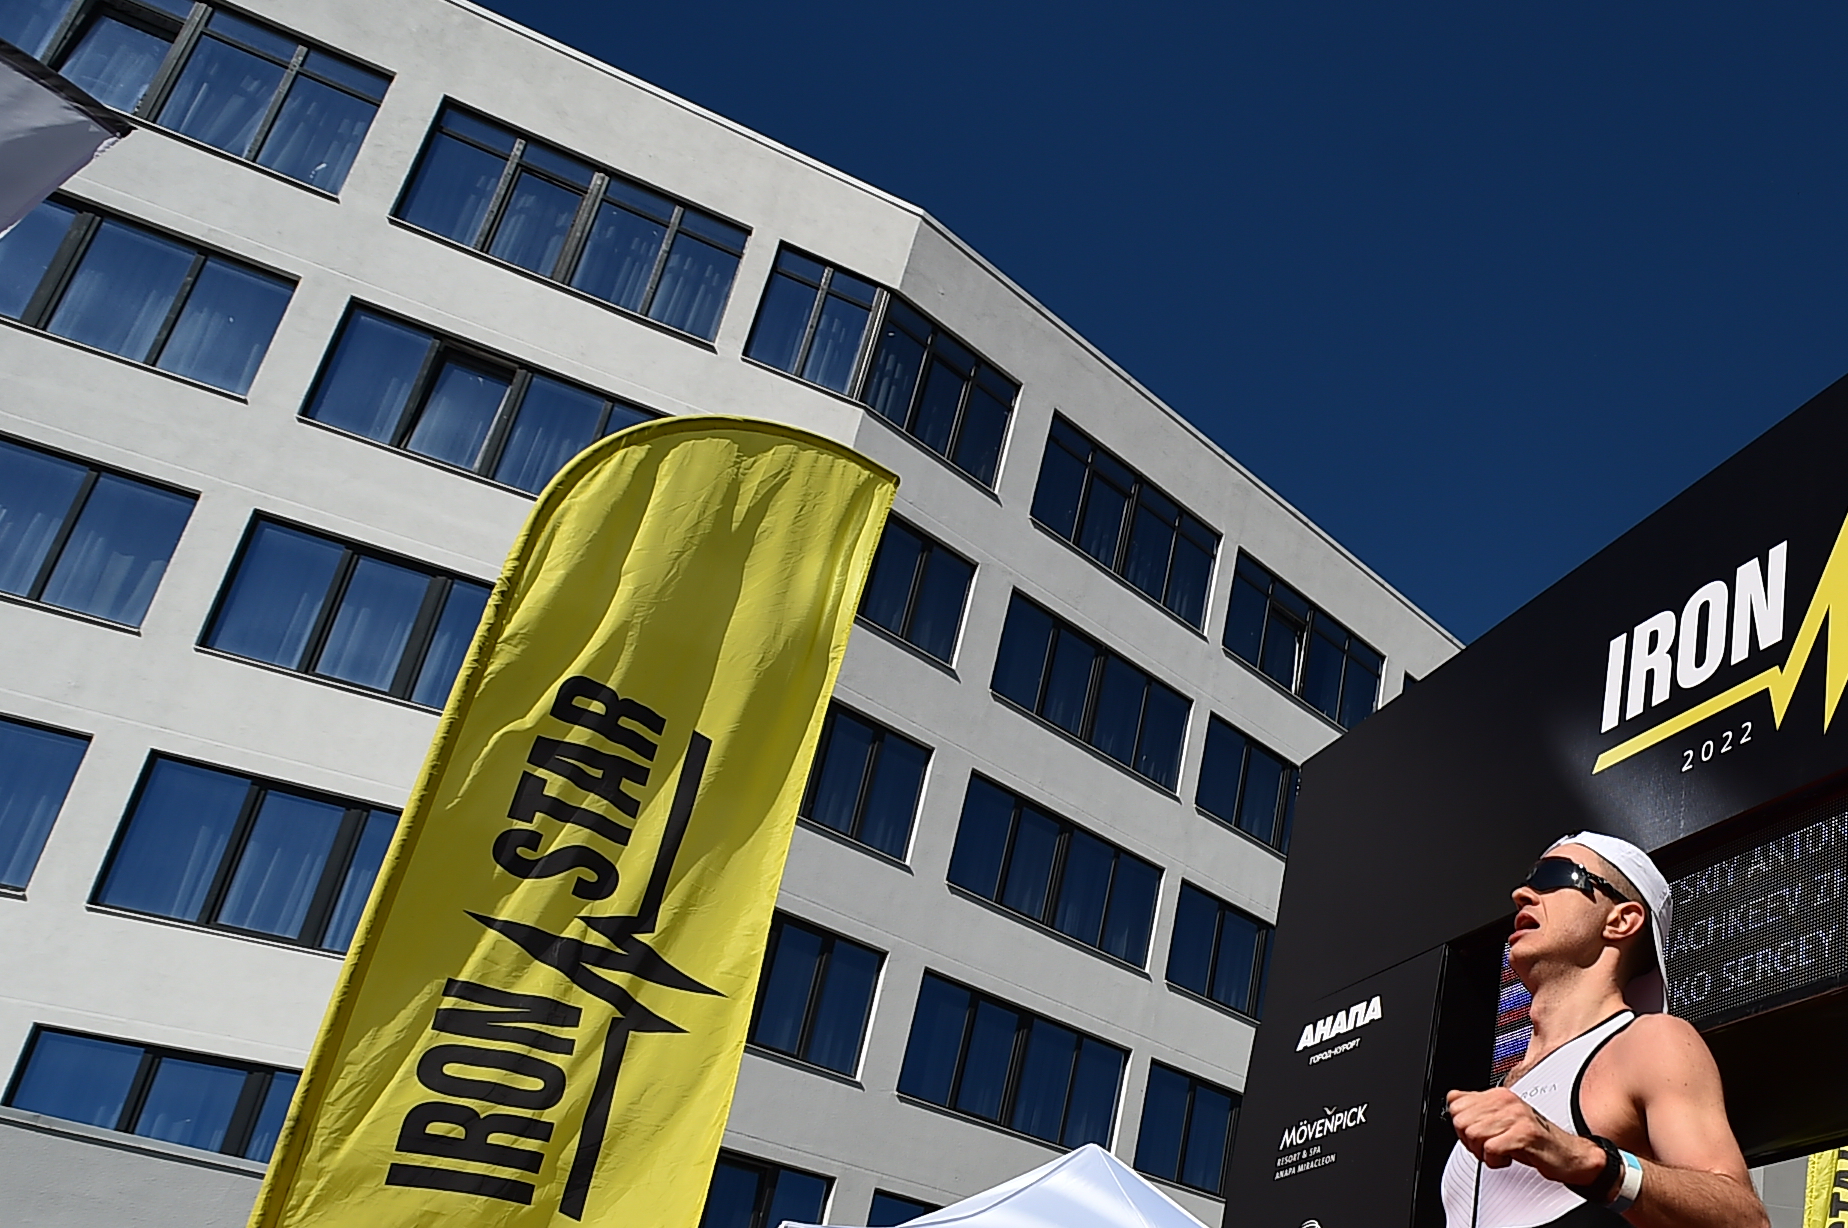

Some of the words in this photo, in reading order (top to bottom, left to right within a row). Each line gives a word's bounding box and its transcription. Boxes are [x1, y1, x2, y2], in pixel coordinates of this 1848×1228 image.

[1601, 541, 1787, 733] IRON
[1681, 721, 1753, 773] 2022
[384, 977, 584, 1206] IRON
[492, 674, 667, 901] STAR
[1668, 970, 1711, 1008] KO
[1722, 925, 1838, 992] SERGEY
[1296, 995, 1382, 1052] АНАПА
[1279, 1103, 1368, 1150] MÖVENPICK
[1274, 1165, 1296, 1181] ANAPA
[1297, 1153, 1336, 1173] MIRACLEON
[1276, 1151, 1301, 1167] RESORT
[1309, 1145, 1322, 1157] SPA
